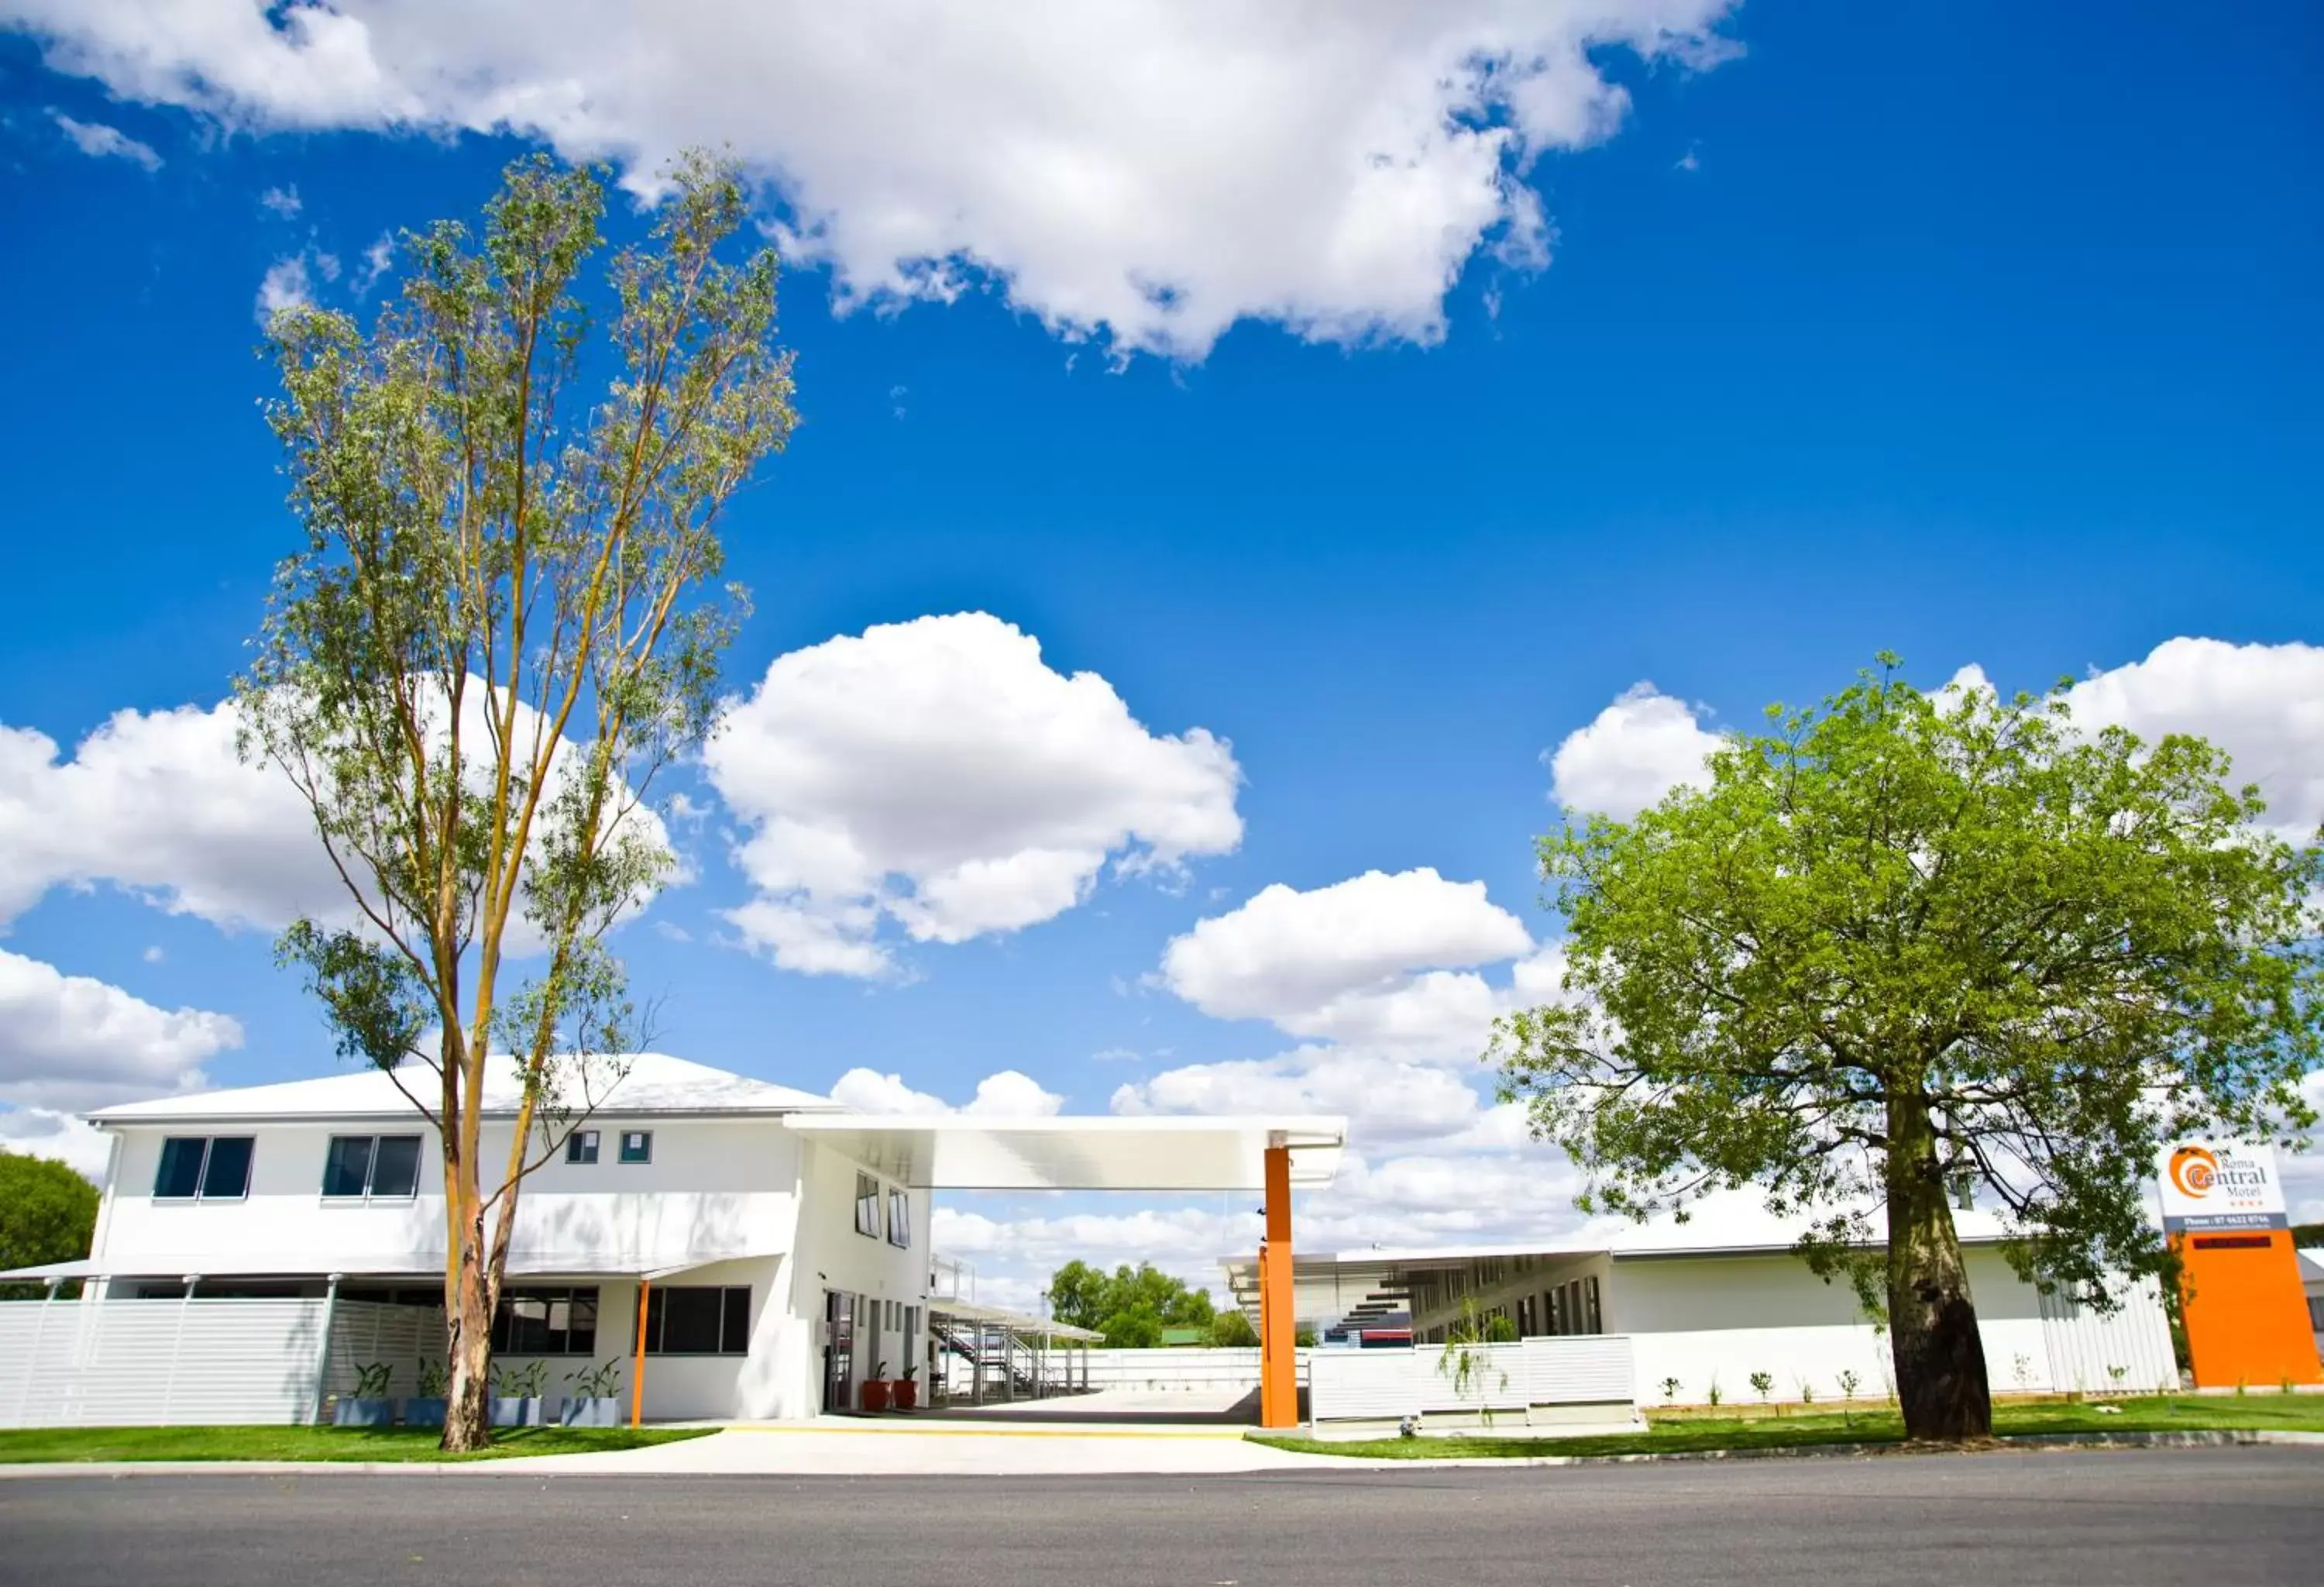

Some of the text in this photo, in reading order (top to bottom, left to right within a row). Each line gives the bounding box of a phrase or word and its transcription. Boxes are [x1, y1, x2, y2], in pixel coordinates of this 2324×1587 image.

[2221, 1158, 2255, 1169] Roma
[2192, 1167, 2267, 1186] Central
[2227, 1186, 2260, 1197] Motel
